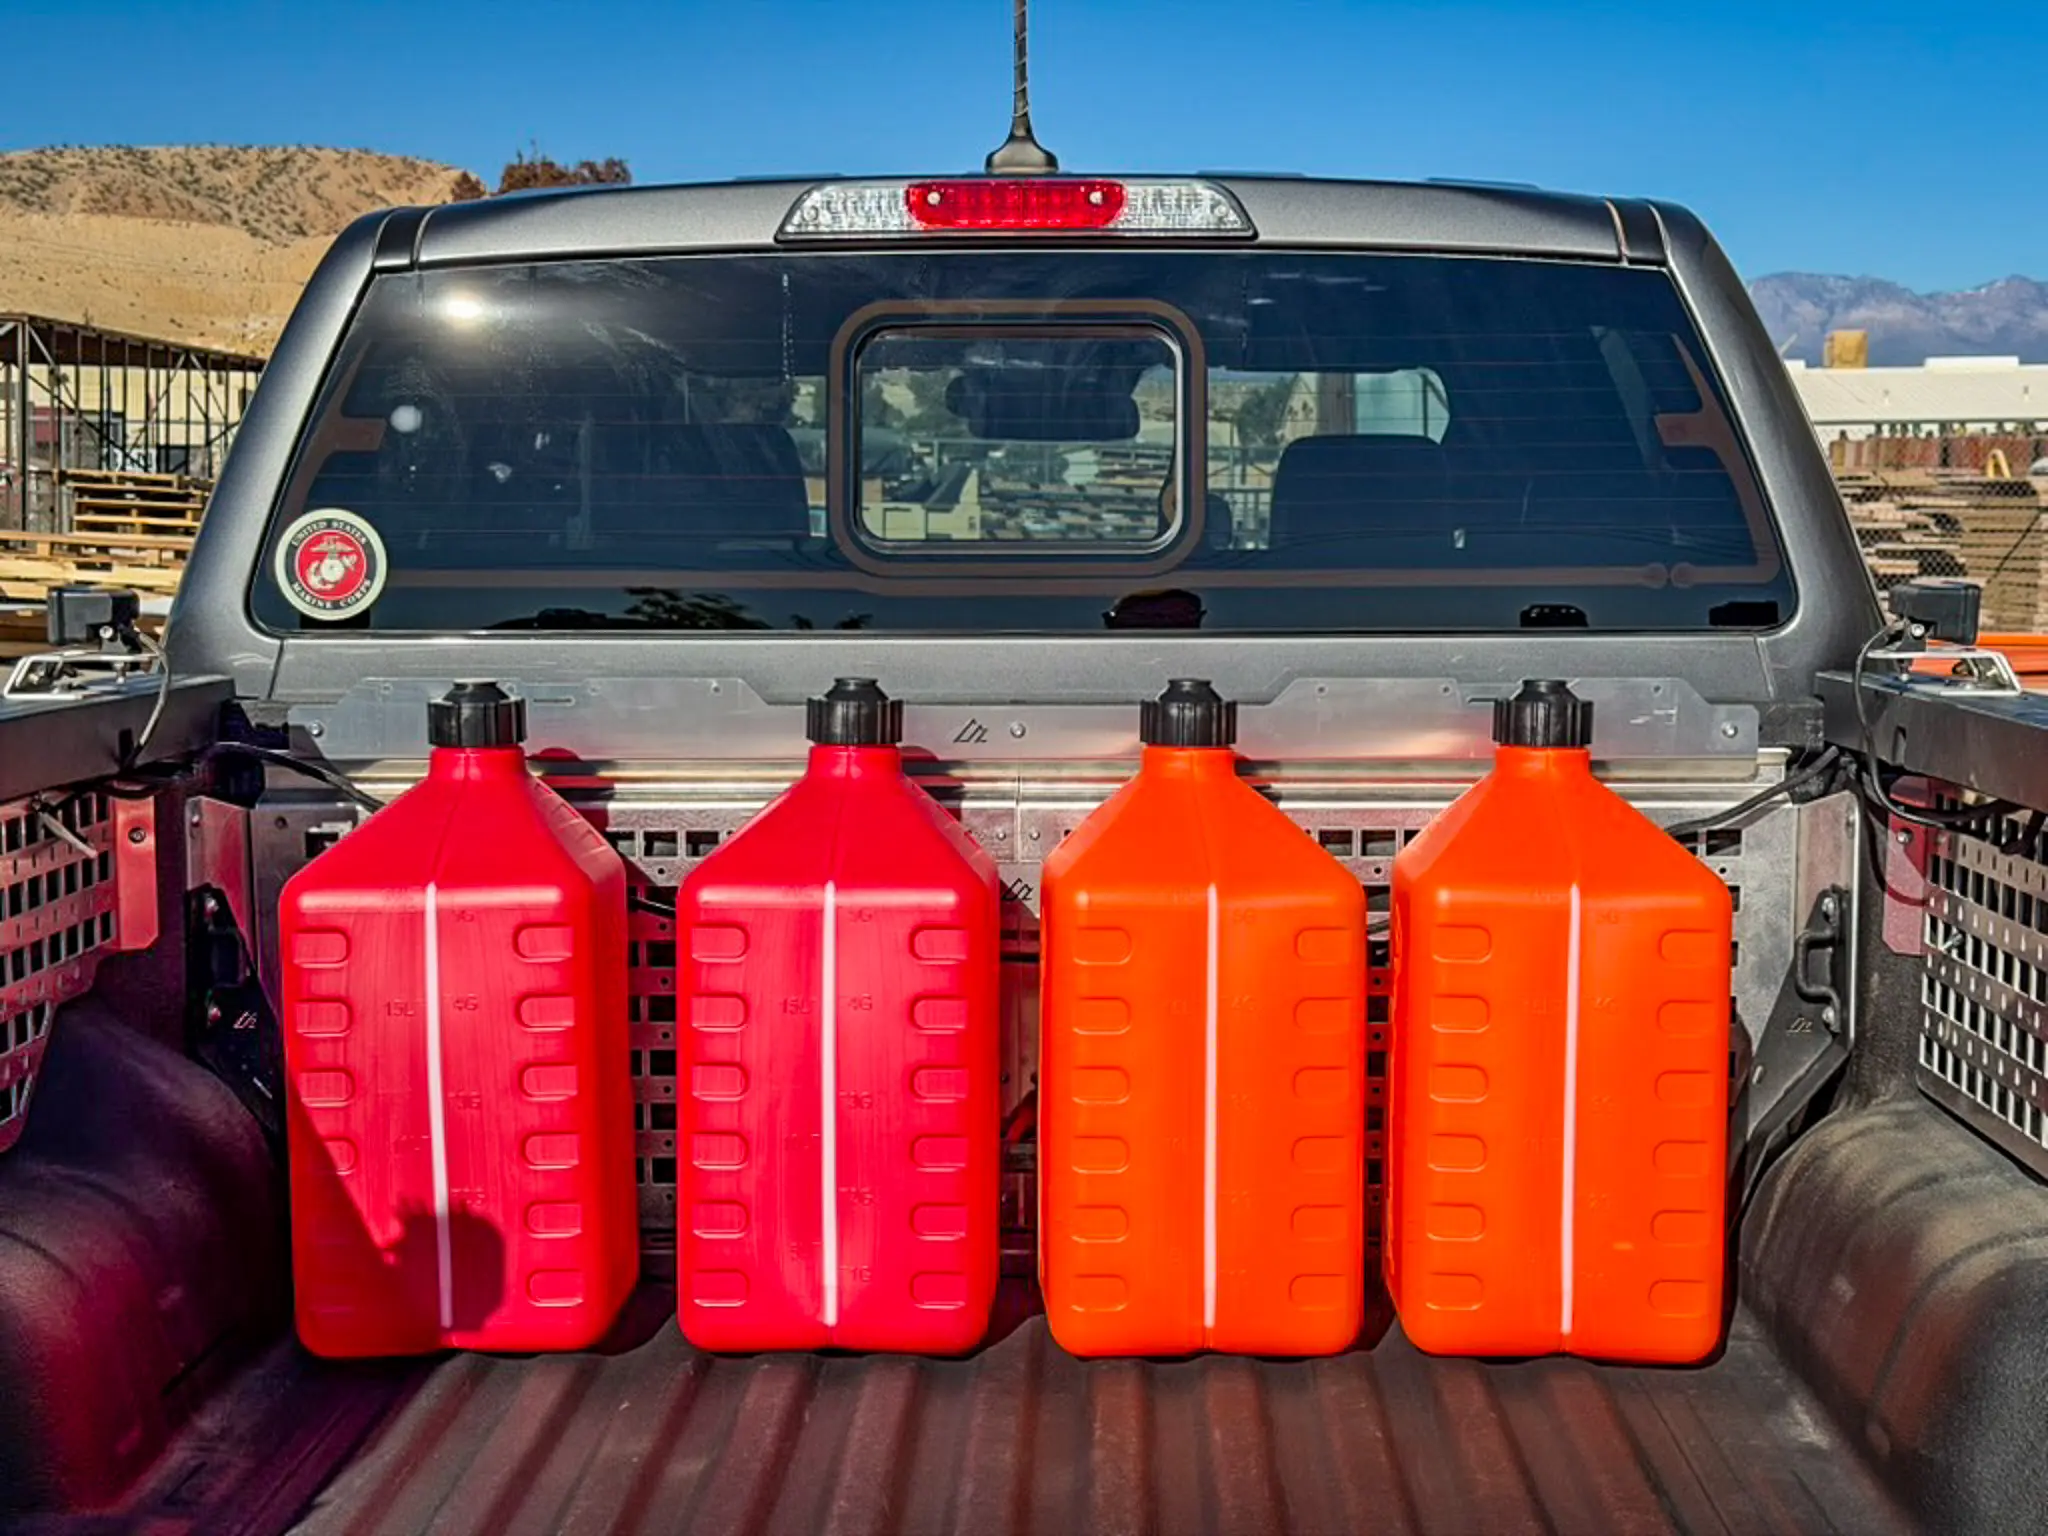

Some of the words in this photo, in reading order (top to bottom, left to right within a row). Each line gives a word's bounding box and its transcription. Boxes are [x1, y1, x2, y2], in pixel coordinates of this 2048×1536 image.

[291, 520, 328, 547] UNITED
[331, 520, 367, 545] STATES
[292, 581, 332, 609] MARINE
[339, 579, 371, 607] CORPS
